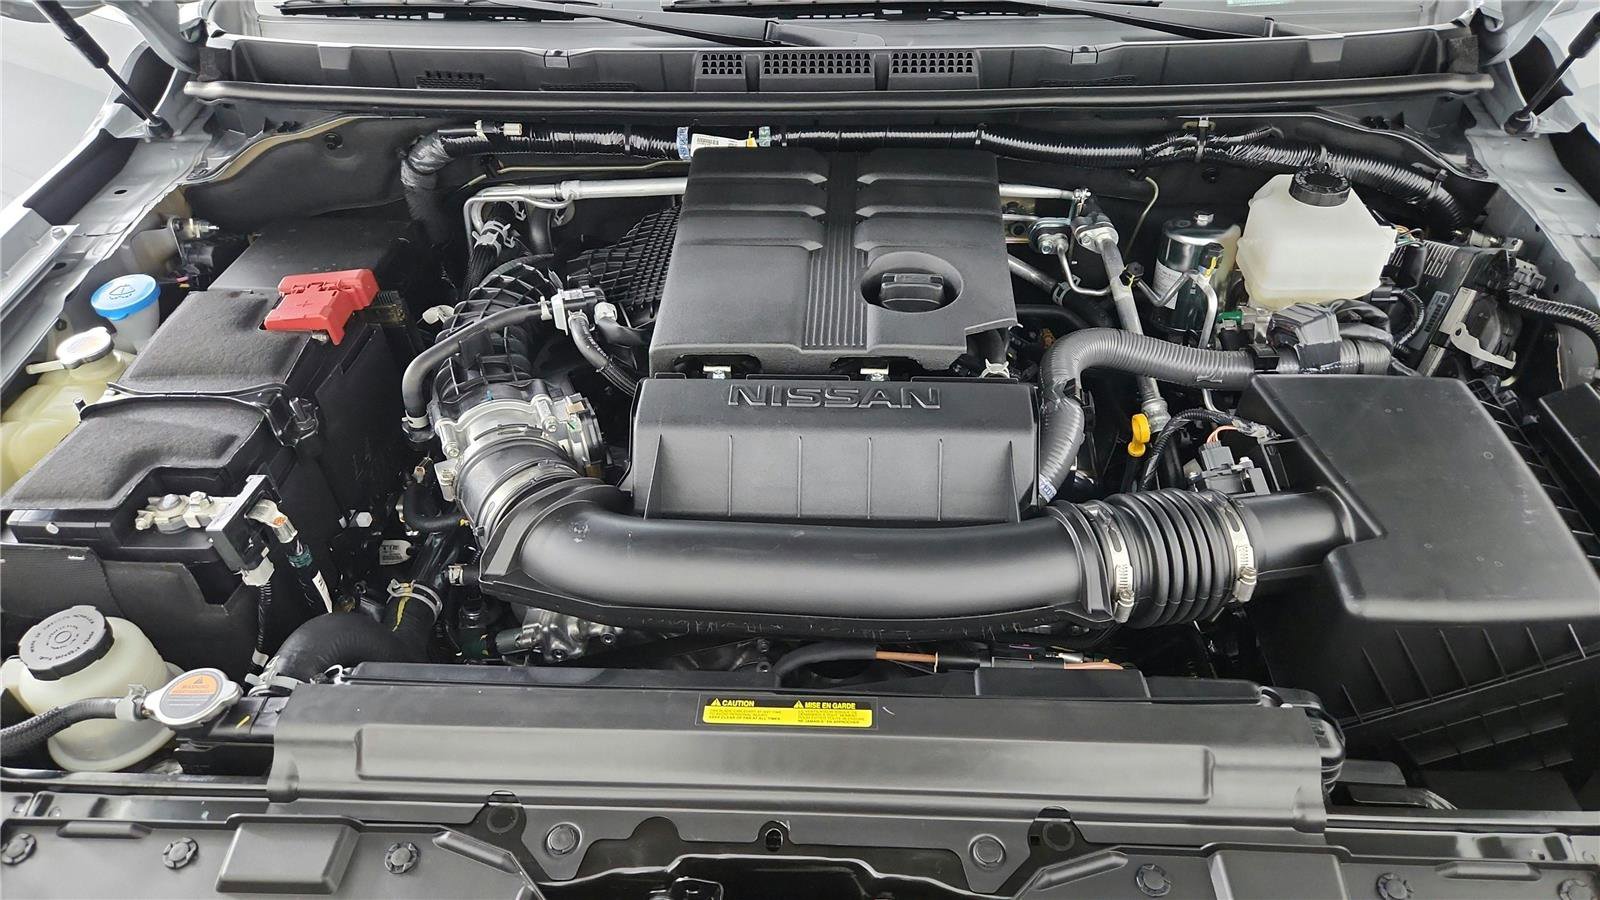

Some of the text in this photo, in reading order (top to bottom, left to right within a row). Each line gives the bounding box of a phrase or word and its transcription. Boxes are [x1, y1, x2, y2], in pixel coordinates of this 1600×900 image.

[728, 384, 941, 409] NISSAN
[721, 699, 755, 707] CAUTION
[804, 701, 821, 709] MISE
[832, 702, 856, 710] GARDE
